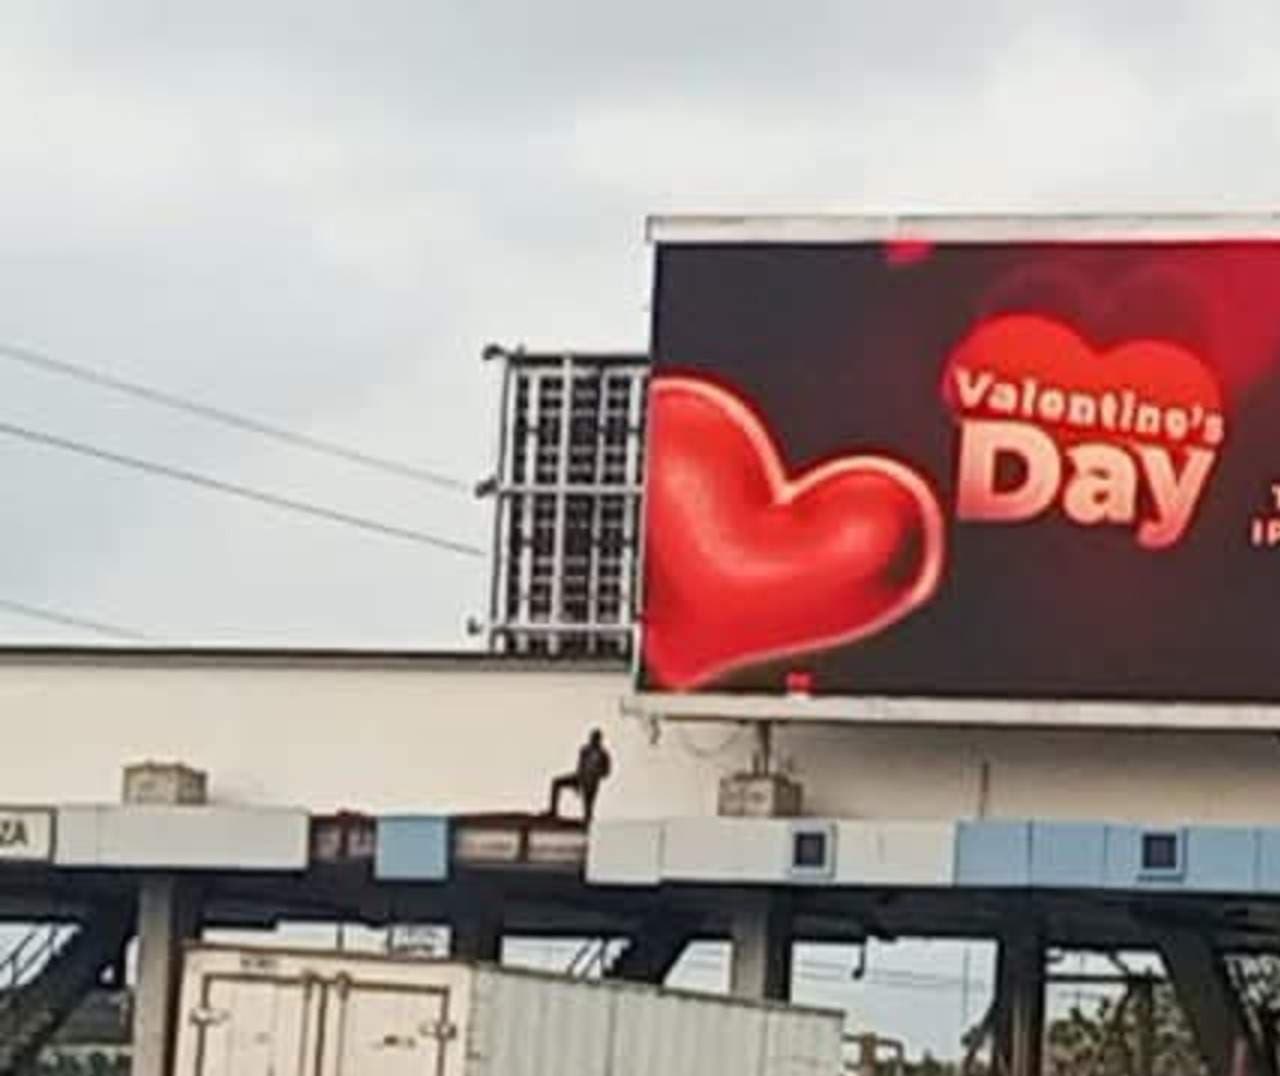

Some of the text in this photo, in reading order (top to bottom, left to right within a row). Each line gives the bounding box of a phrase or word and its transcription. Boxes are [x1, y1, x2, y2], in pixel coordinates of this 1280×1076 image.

[954, 369, 1225, 445] Valentine's
[955, 418, 1216, 549] Day
[1252, 521, 1263, 545] I
